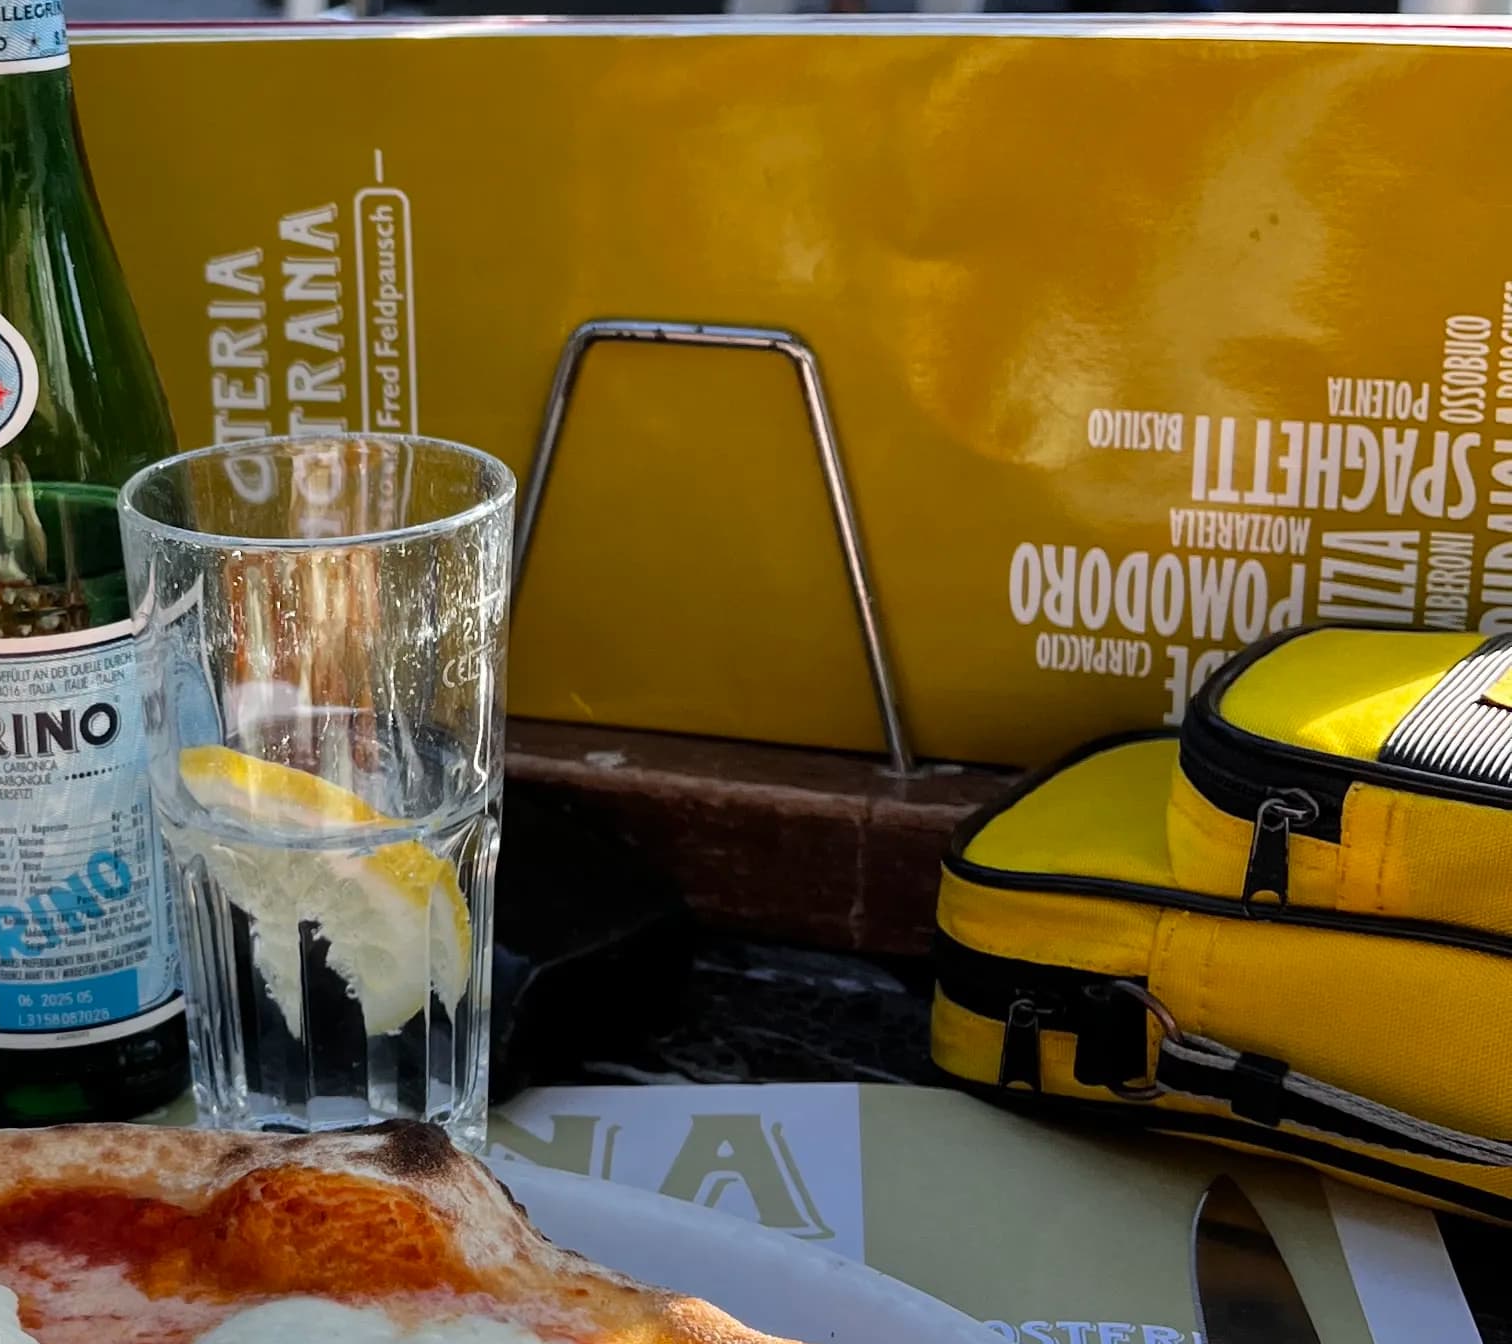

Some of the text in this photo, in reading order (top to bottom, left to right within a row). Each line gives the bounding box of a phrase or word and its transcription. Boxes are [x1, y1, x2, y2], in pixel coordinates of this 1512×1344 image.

[369, 204, 404, 358] Feldpausch
[376, 364, 401, 428] Fred
[1327, 376, 1430, 422] POLENTA
[1439, 314, 1492, 426] OSSOBUCO
[1088, 408, 1184, 452] BASILICO
[1191, 415, 1482, 521] SPAGHETTI
[1169, 507, 1312, 556] MOZZARELLA
[1008, 542, 1305, 643] POMODORO
[1035, 632, 1152, 679] CARPACCIO
